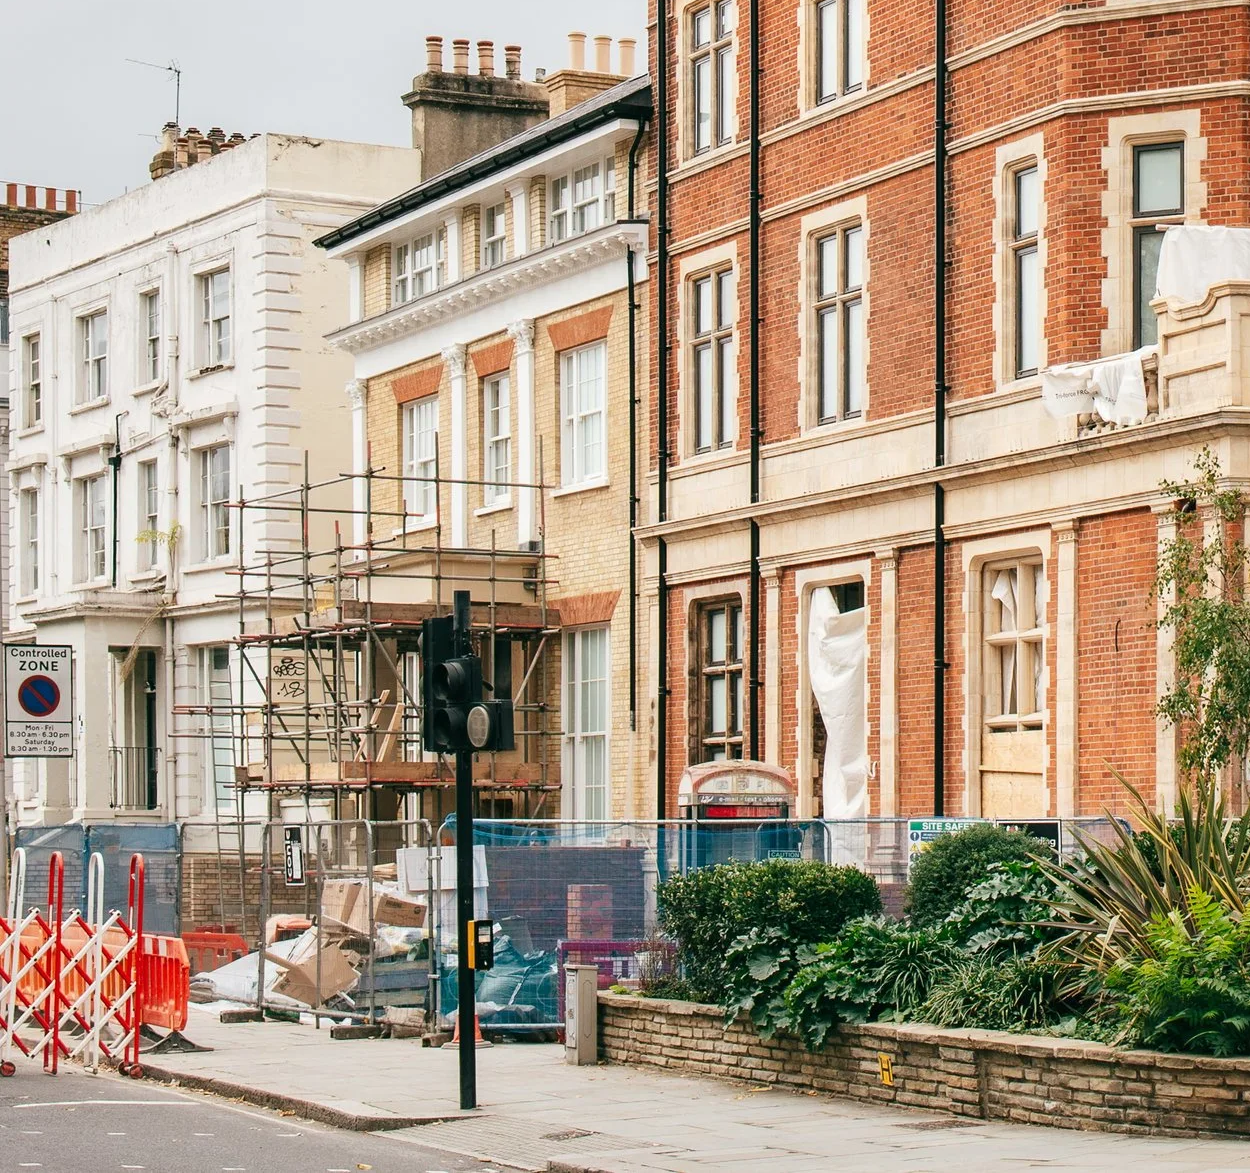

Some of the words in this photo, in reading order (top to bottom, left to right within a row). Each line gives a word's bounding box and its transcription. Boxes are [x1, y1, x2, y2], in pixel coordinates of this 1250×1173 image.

[11, 648, 67, 657] Controlled
[19, 660, 58, 671] ZONE
[922, 822, 943, 830] SITE
